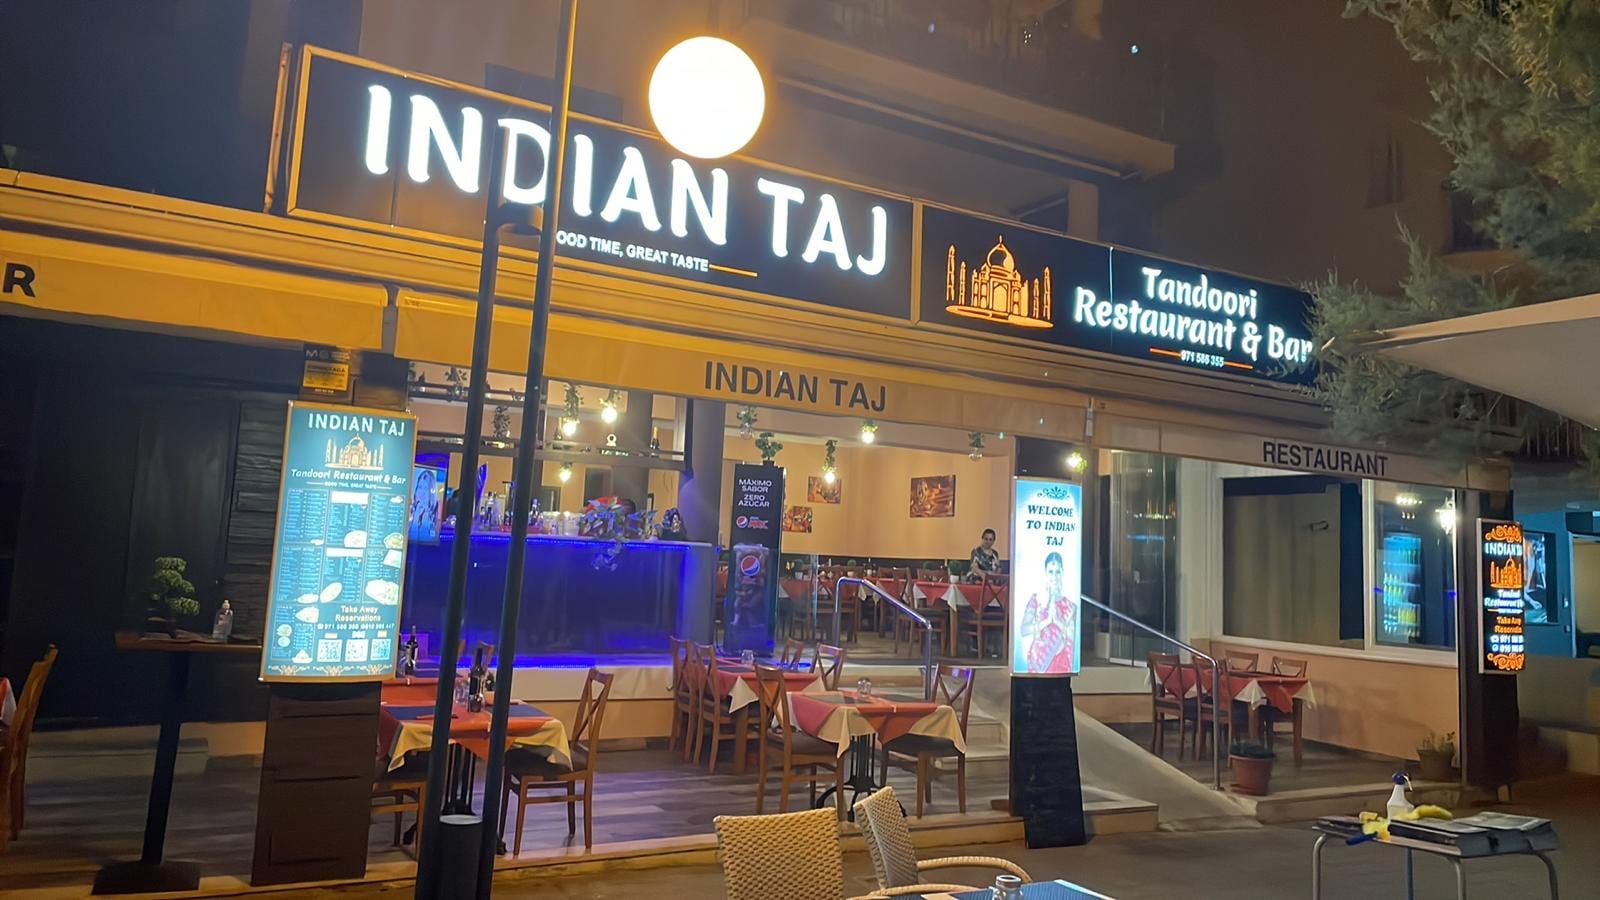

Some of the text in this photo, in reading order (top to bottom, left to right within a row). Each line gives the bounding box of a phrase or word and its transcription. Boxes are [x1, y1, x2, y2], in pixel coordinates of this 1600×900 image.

[365, 85, 888, 276] INDIAN TAJ
[556, 230, 709, 272] OOD TIME, GREAT TASTE
[2, 262, 37, 298] R
[1141, 266, 1258, 320] Tandoori
[1073, 286, 1313, 363] Restaurant & Bar
[704, 361, 886, 413] INDIAN TAJ
[308, 412, 405, 437] INDIAN TAJ
[291, 468, 331, 479] Tandoori
[334, 470, 383, 482] Restaurant
[392, 475, 407, 485] Bar
[1263, 441, 1389, 477] RESTAURANT
[1026, 520, 1076, 532] TO INDIAN
[1028, 505, 1074, 517] WELCOME
[1046, 536, 1064, 546] TAJ
[359, 605, 379, 614] Away
